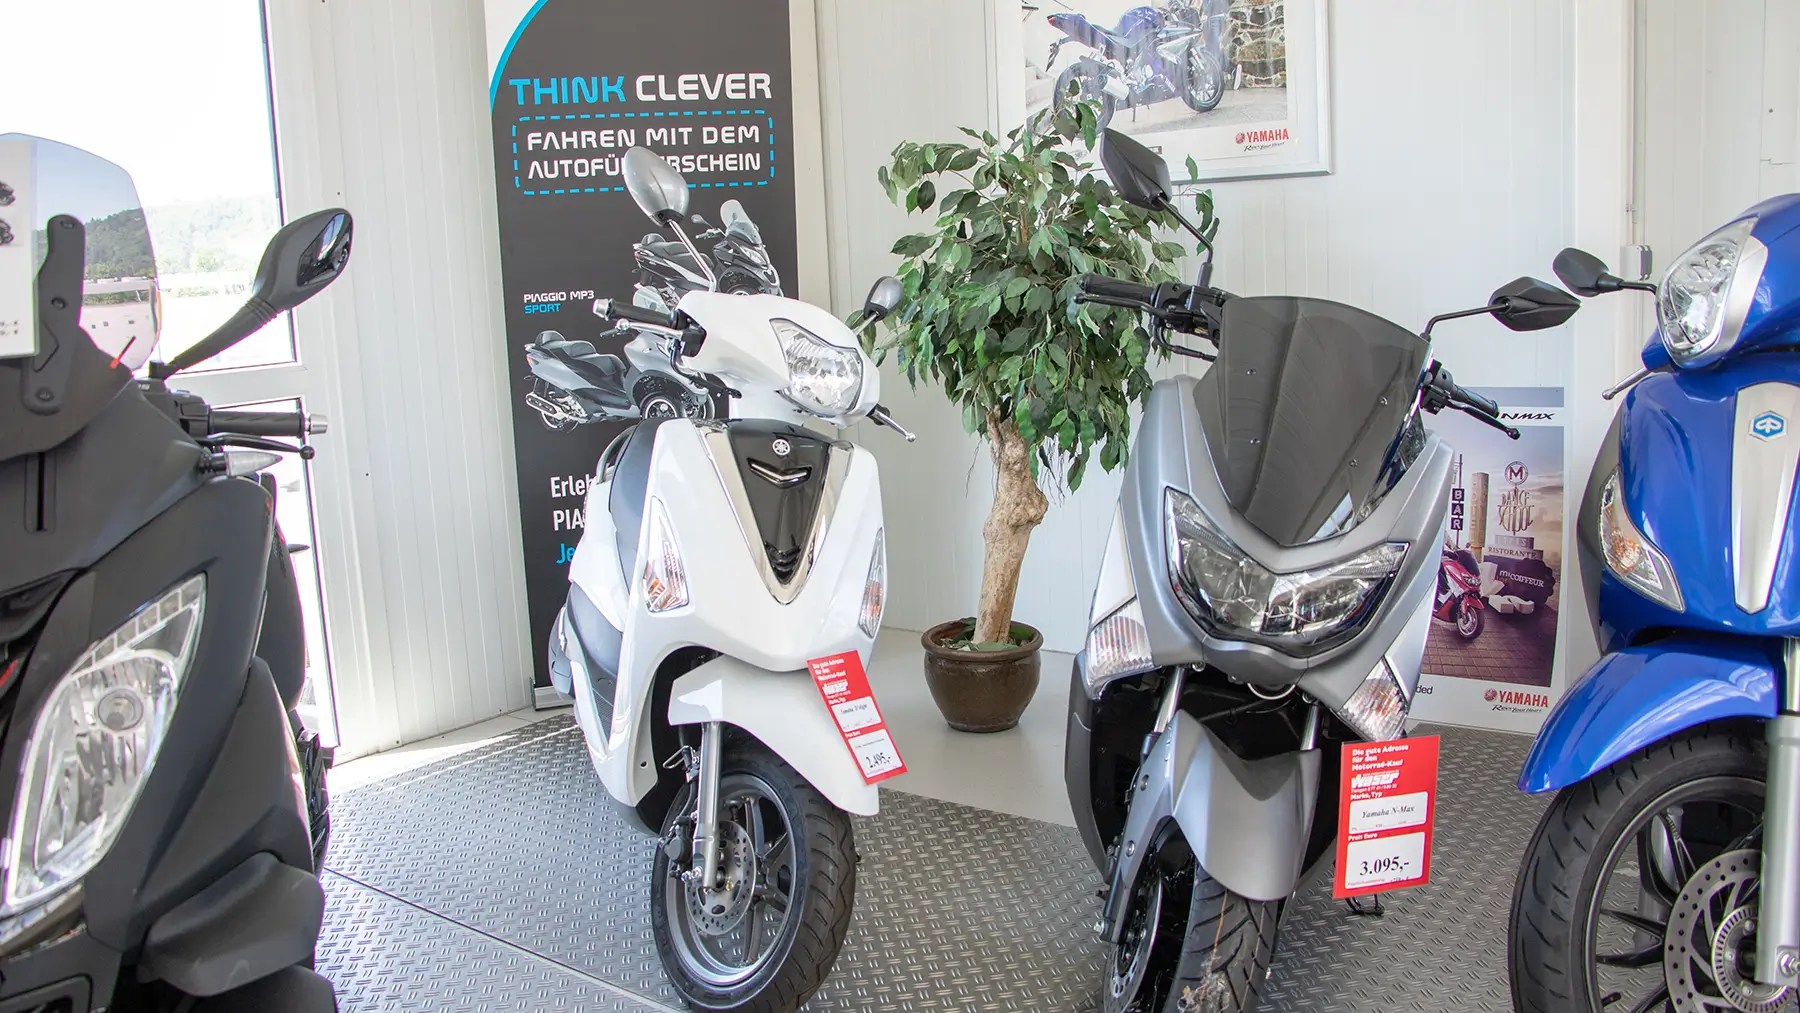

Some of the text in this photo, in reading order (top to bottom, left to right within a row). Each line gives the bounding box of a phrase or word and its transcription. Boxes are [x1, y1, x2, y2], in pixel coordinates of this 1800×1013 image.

[509, 72, 773, 106] THINK CLEVER
[527, 125, 760, 151] FAHREN MIT DEM
[1246, 128, 1289, 143] YAMAHA
[528, 152, 761, 179] AUTOFÜRSCHEIN
[524, 290, 595, 303] PIAGGIO MP3
[525, 303, 561, 314] SPORT
[1453, 489, 1463, 530] BAR
[553, 508, 585, 531] PIA
[1488, 546, 1537, 559] RISTORANTE
[1499, 690, 1549, 708] YAMAHA
[1382, 744, 1409, 753] Adresse
[1362, 809, 1390, 818] Yamaha
[1360, 856, 1410, 876] 3.095,-
